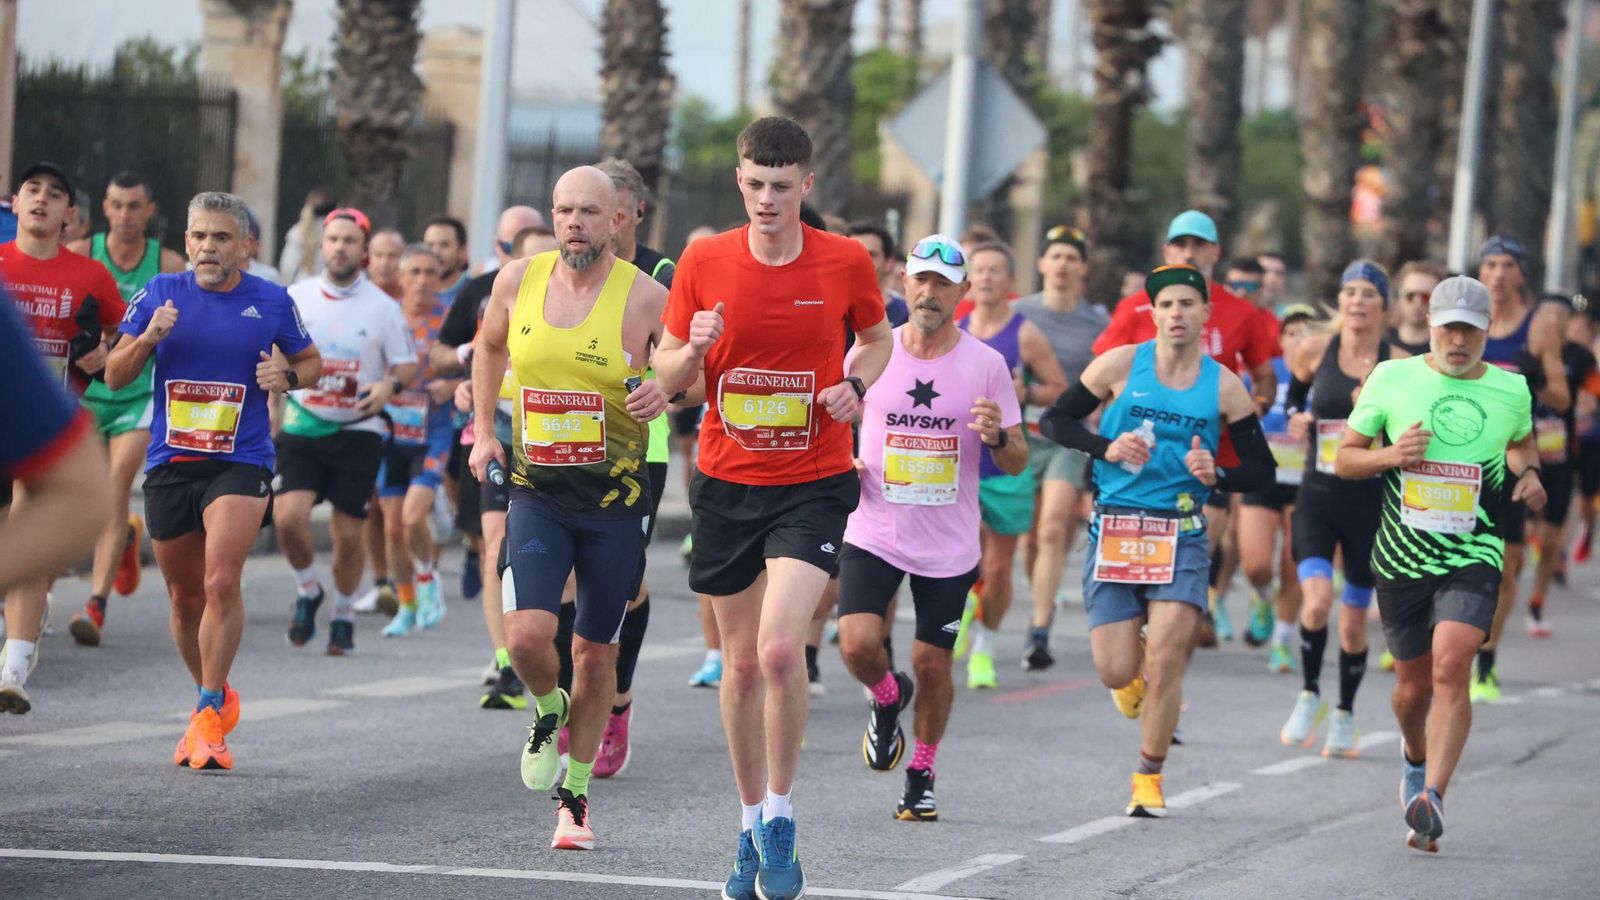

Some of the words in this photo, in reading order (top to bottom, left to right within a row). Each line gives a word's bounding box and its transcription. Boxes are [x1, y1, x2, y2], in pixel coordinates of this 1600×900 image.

[14, 283, 58, 296] GENERALI
[15, 299, 57, 318] MÁLAGA
[746, 374, 808, 388] GENERALI
[187, 384, 239, 398] GENERALI
[541, 394, 598, 407] GENERALI
[743, 399, 788, 416] 6126
[191, 406, 218, 420] 848
[1130, 404, 1208, 430] SPARTA
[542, 417, 582, 433] 5642
[886, 413, 957, 430] SAYSKY
[904, 437, 954, 451] GENERALI
[897, 459, 945, 475] 15589
[1421, 463, 1475, 478] GENERALI
[1415, 484, 1461, 503] 13501
[1119, 541, 1157, 557] 2219
